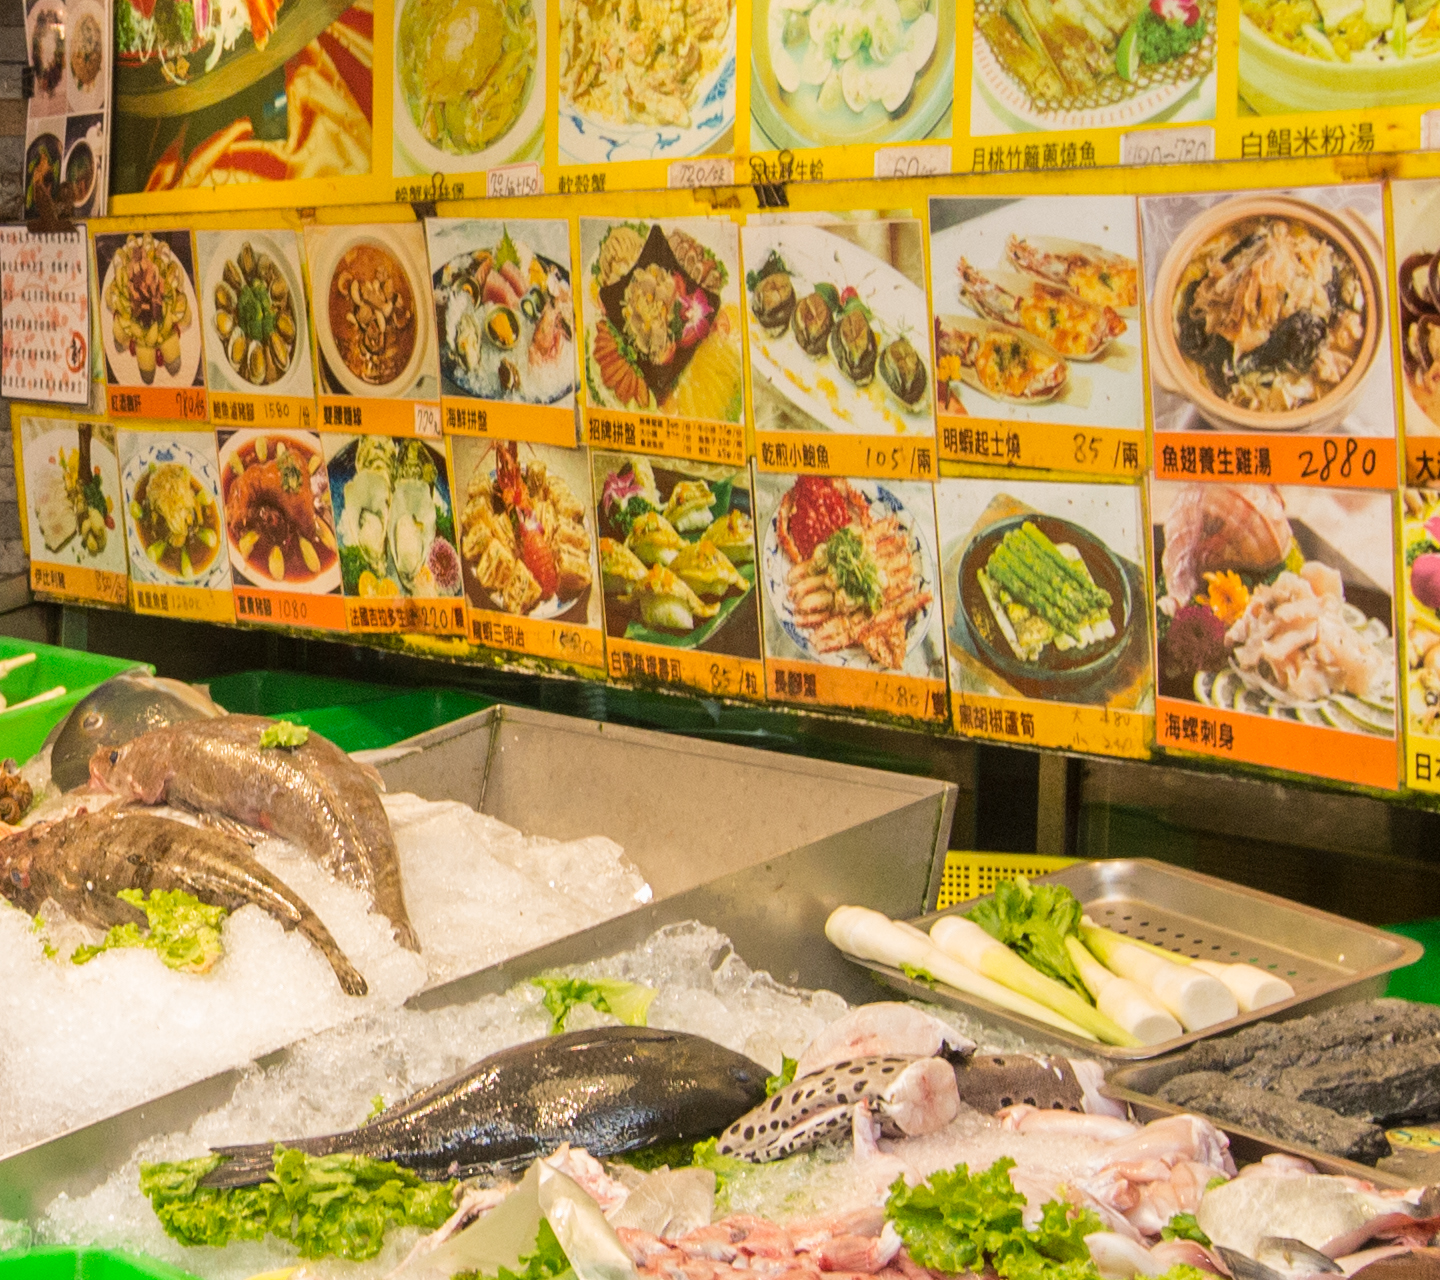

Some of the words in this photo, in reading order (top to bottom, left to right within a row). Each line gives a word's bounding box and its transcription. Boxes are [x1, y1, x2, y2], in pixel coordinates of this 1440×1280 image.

[1239, 122, 1376, 161] 白鯧米粉湯
[942, 427, 1022, 460] 明蝦起士燒
[1161, 443, 1273, 480] 魚翅養生雞湯
[1298, 446, 1378, 481] 2880
[1163, 710, 1235, 751] 海螺刺身
